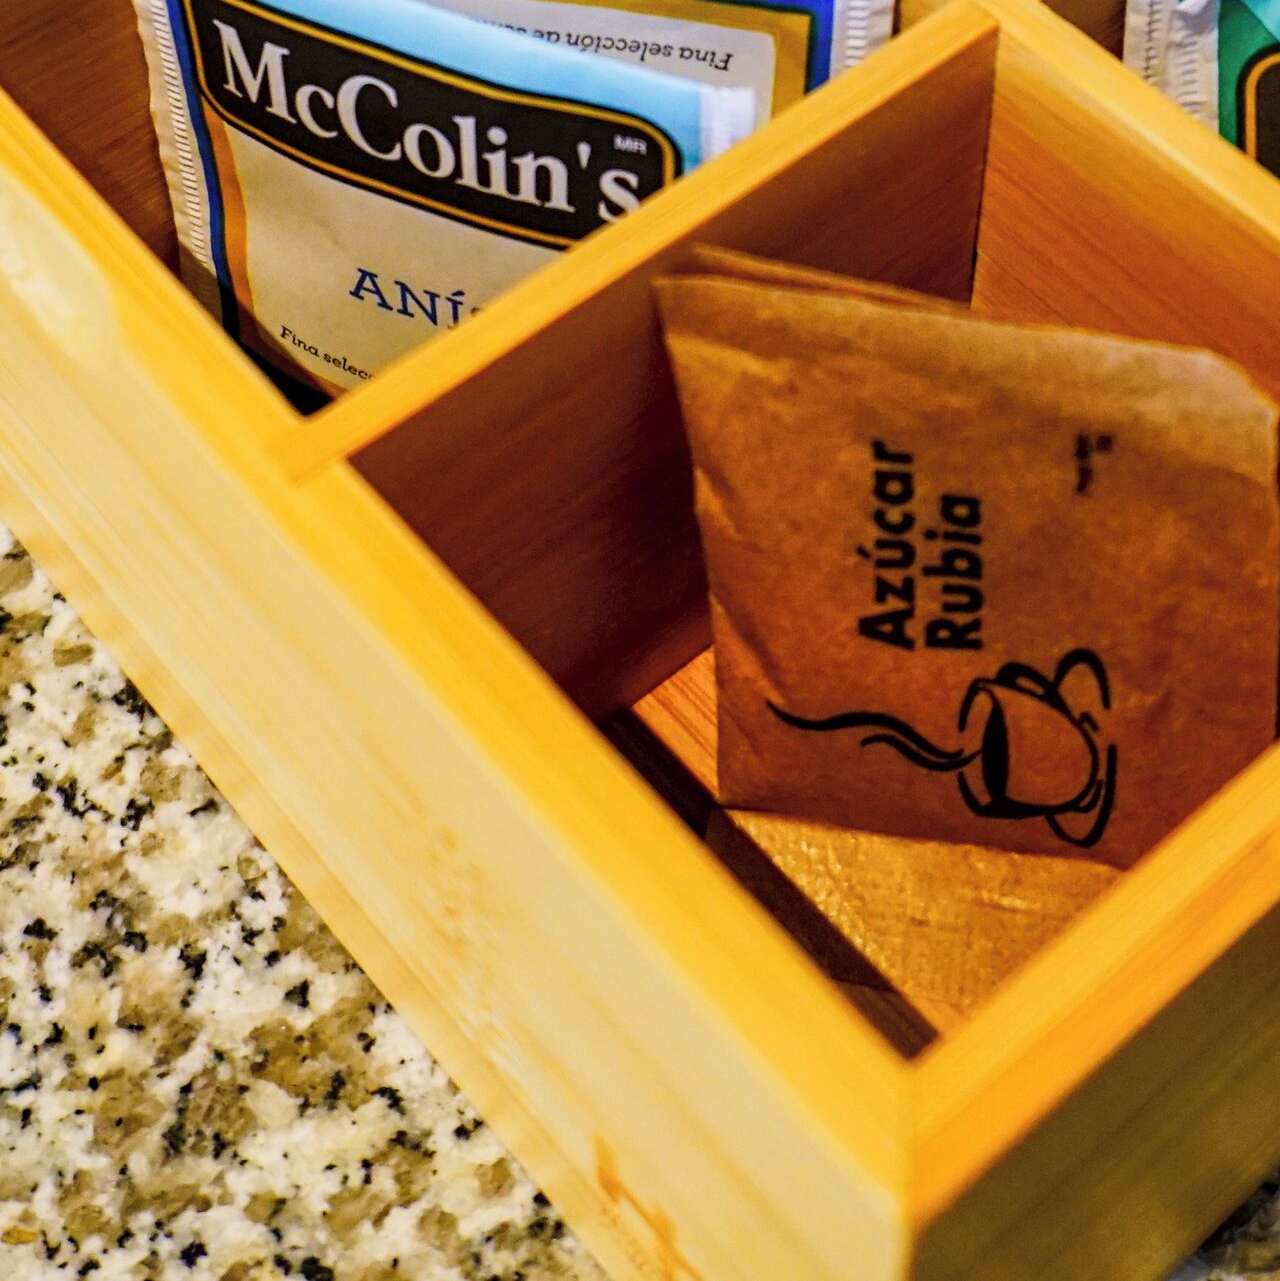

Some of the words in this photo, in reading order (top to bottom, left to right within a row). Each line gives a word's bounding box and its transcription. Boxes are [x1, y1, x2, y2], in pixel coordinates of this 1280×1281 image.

[566, 31, 672, 62] selección
[678, 47, 734, 72] Fina
[212, 20, 641, 223] McColin's
[614, 134, 648, 155] MR
[349, 267, 482, 328] ANÍ
[280, 325, 320, 358] Fina
[855, 439, 916, 652] Azúcar
[922, 494, 984, 650] Rubia
